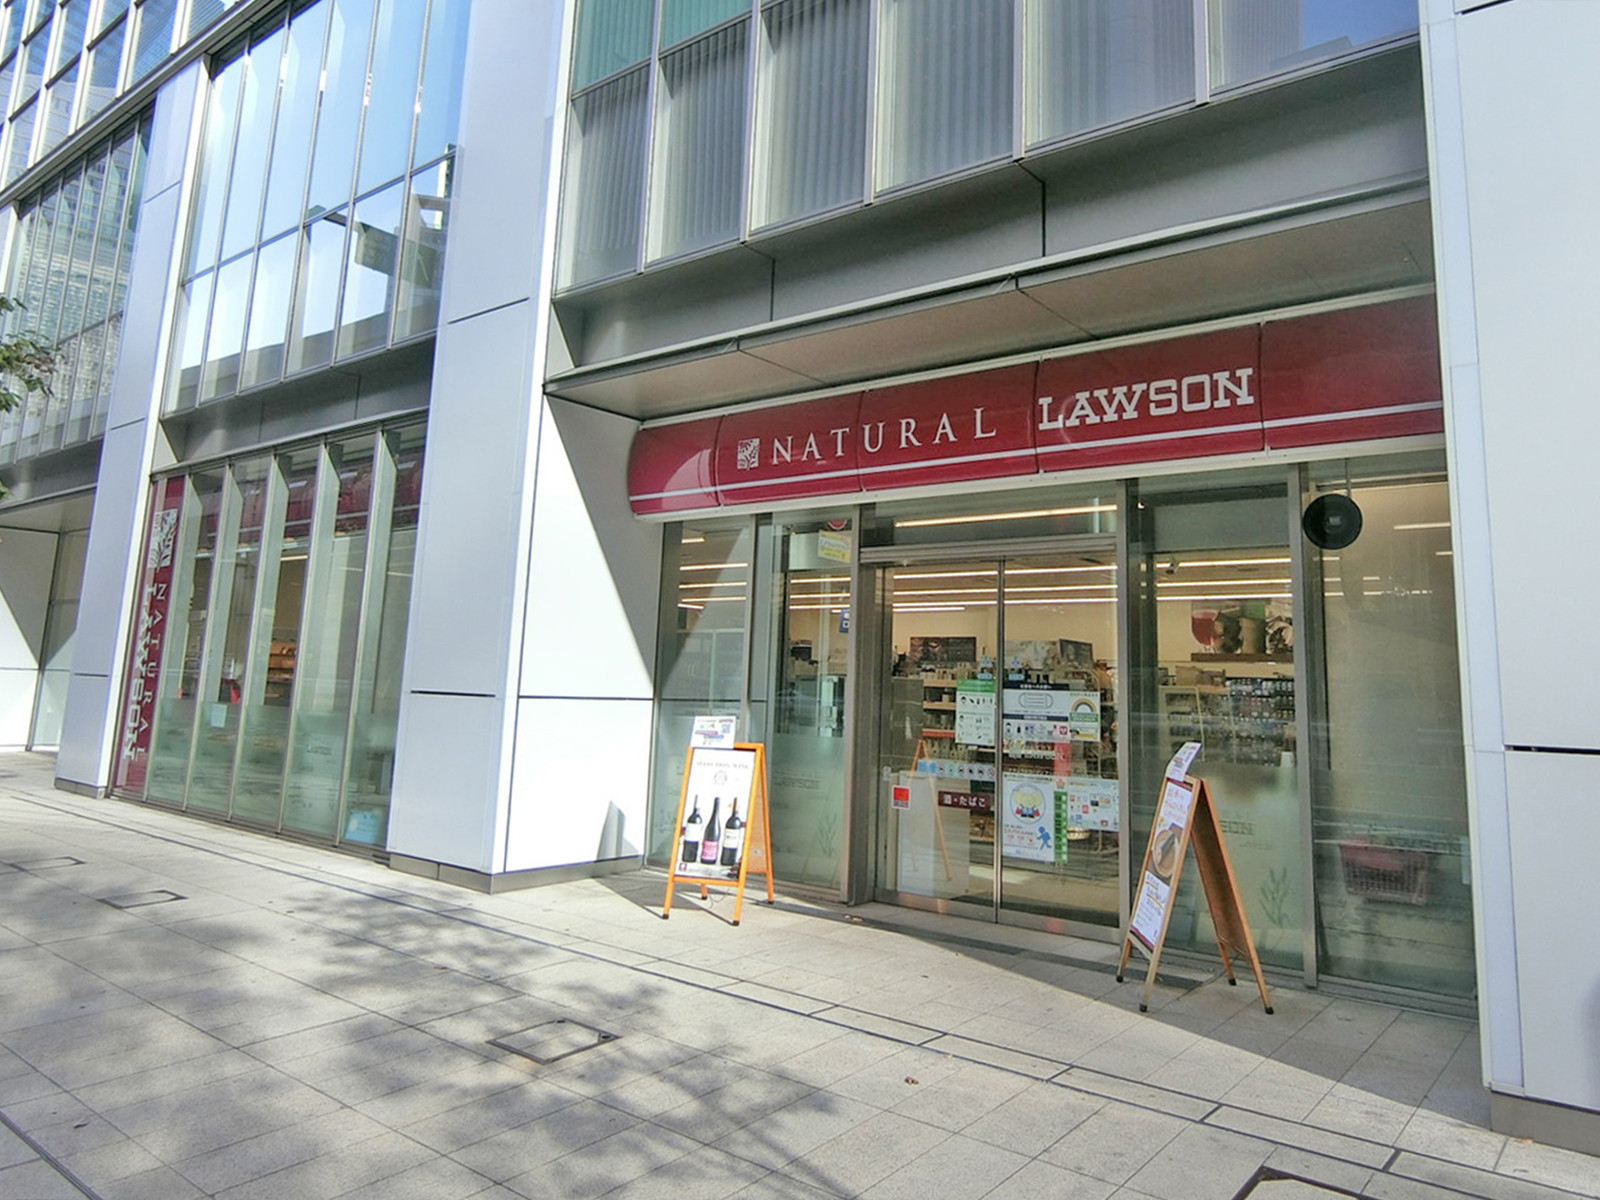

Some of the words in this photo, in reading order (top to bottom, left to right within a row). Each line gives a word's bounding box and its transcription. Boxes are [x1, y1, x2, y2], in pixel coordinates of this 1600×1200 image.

[771, 406, 997, 466] NATURAL
[1037, 367, 1254, 431] LAWSON
[123, 583, 157, 761] LAWSON
[137, 583, 167, 754] NATURAL
